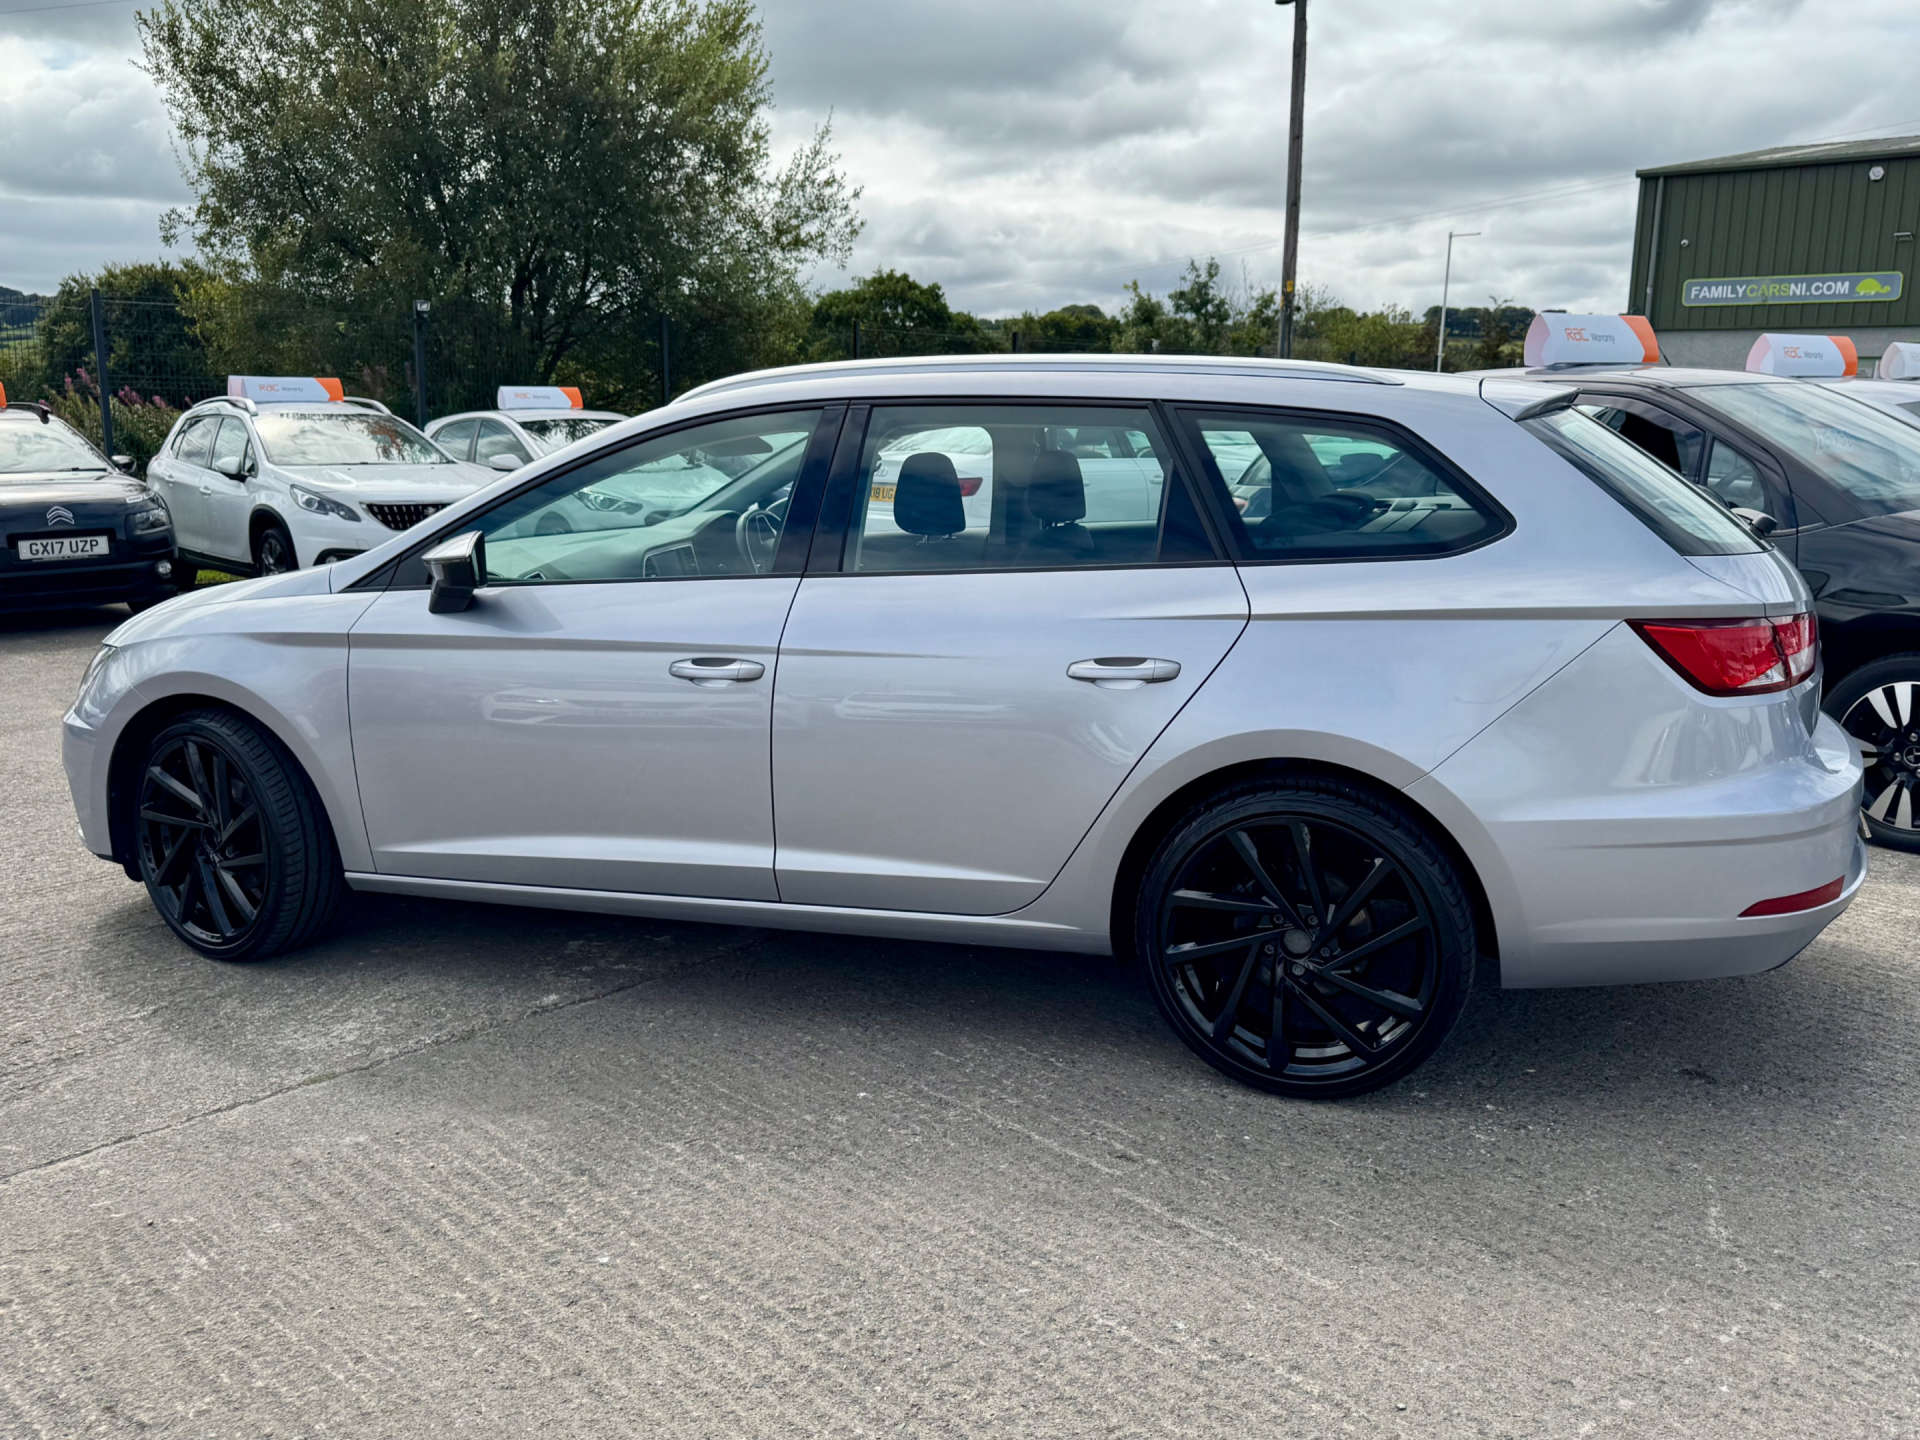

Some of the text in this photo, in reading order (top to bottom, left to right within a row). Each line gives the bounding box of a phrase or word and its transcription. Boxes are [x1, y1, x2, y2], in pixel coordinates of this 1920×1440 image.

[1690, 280, 1850, 300] FAMILYCARSNI.COM
[29, 539, 99, 557] GX17 UZP
